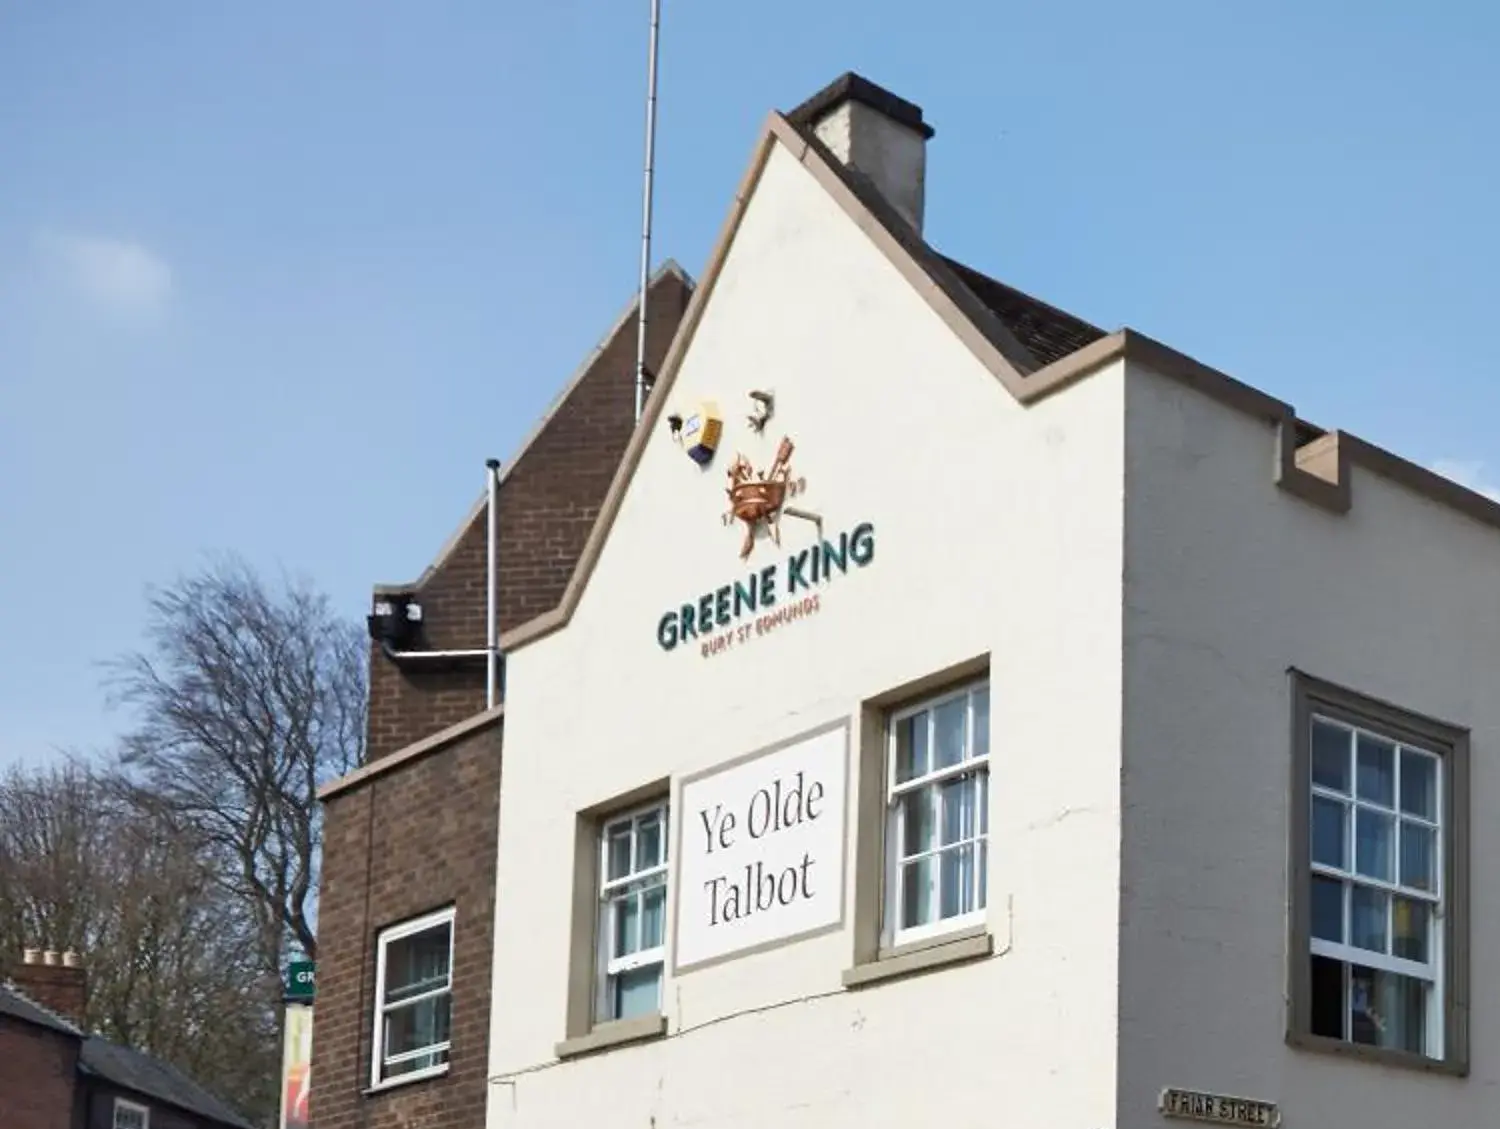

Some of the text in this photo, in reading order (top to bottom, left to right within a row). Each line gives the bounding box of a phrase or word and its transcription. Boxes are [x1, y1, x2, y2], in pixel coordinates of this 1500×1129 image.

[657, 522, 874, 651] GREENE KING
[699, 771, 824, 854] Ye Olde
[703, 853, 816, 926] Talbot
[1219, 1099, 1274, 1125] STREET
